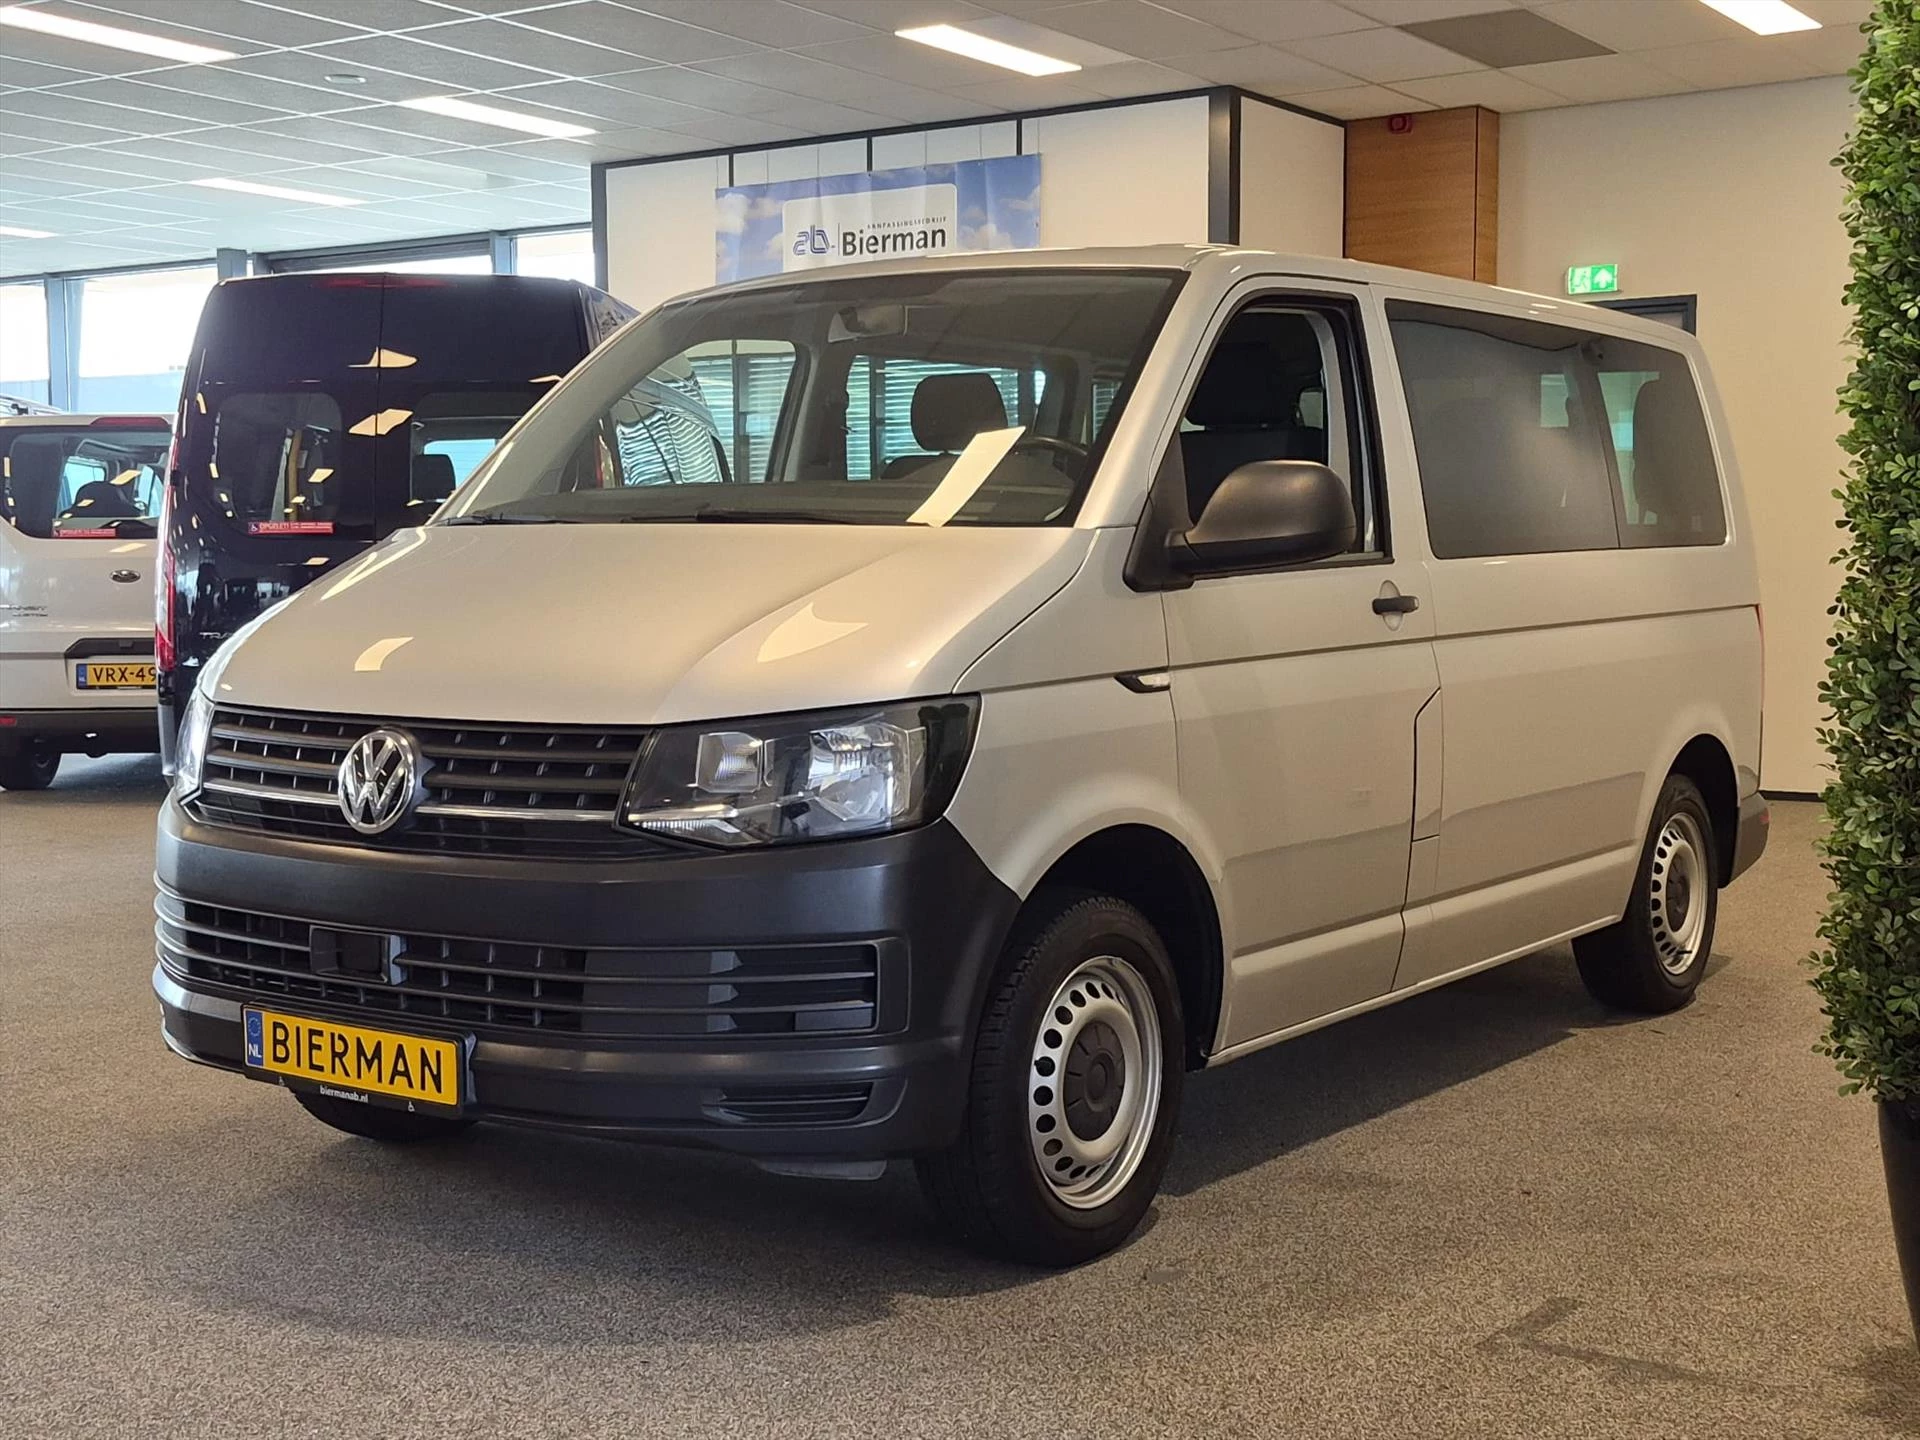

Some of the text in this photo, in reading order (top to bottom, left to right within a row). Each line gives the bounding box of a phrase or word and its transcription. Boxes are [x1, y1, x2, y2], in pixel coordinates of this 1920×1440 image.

[842, 228, 946, 257] Bierman
[248, 1043, 262, 1058] NL
[272, 1021, 442, 1094] BIERMAN
[319, 1084, 369, 1104] biermanab.nl
